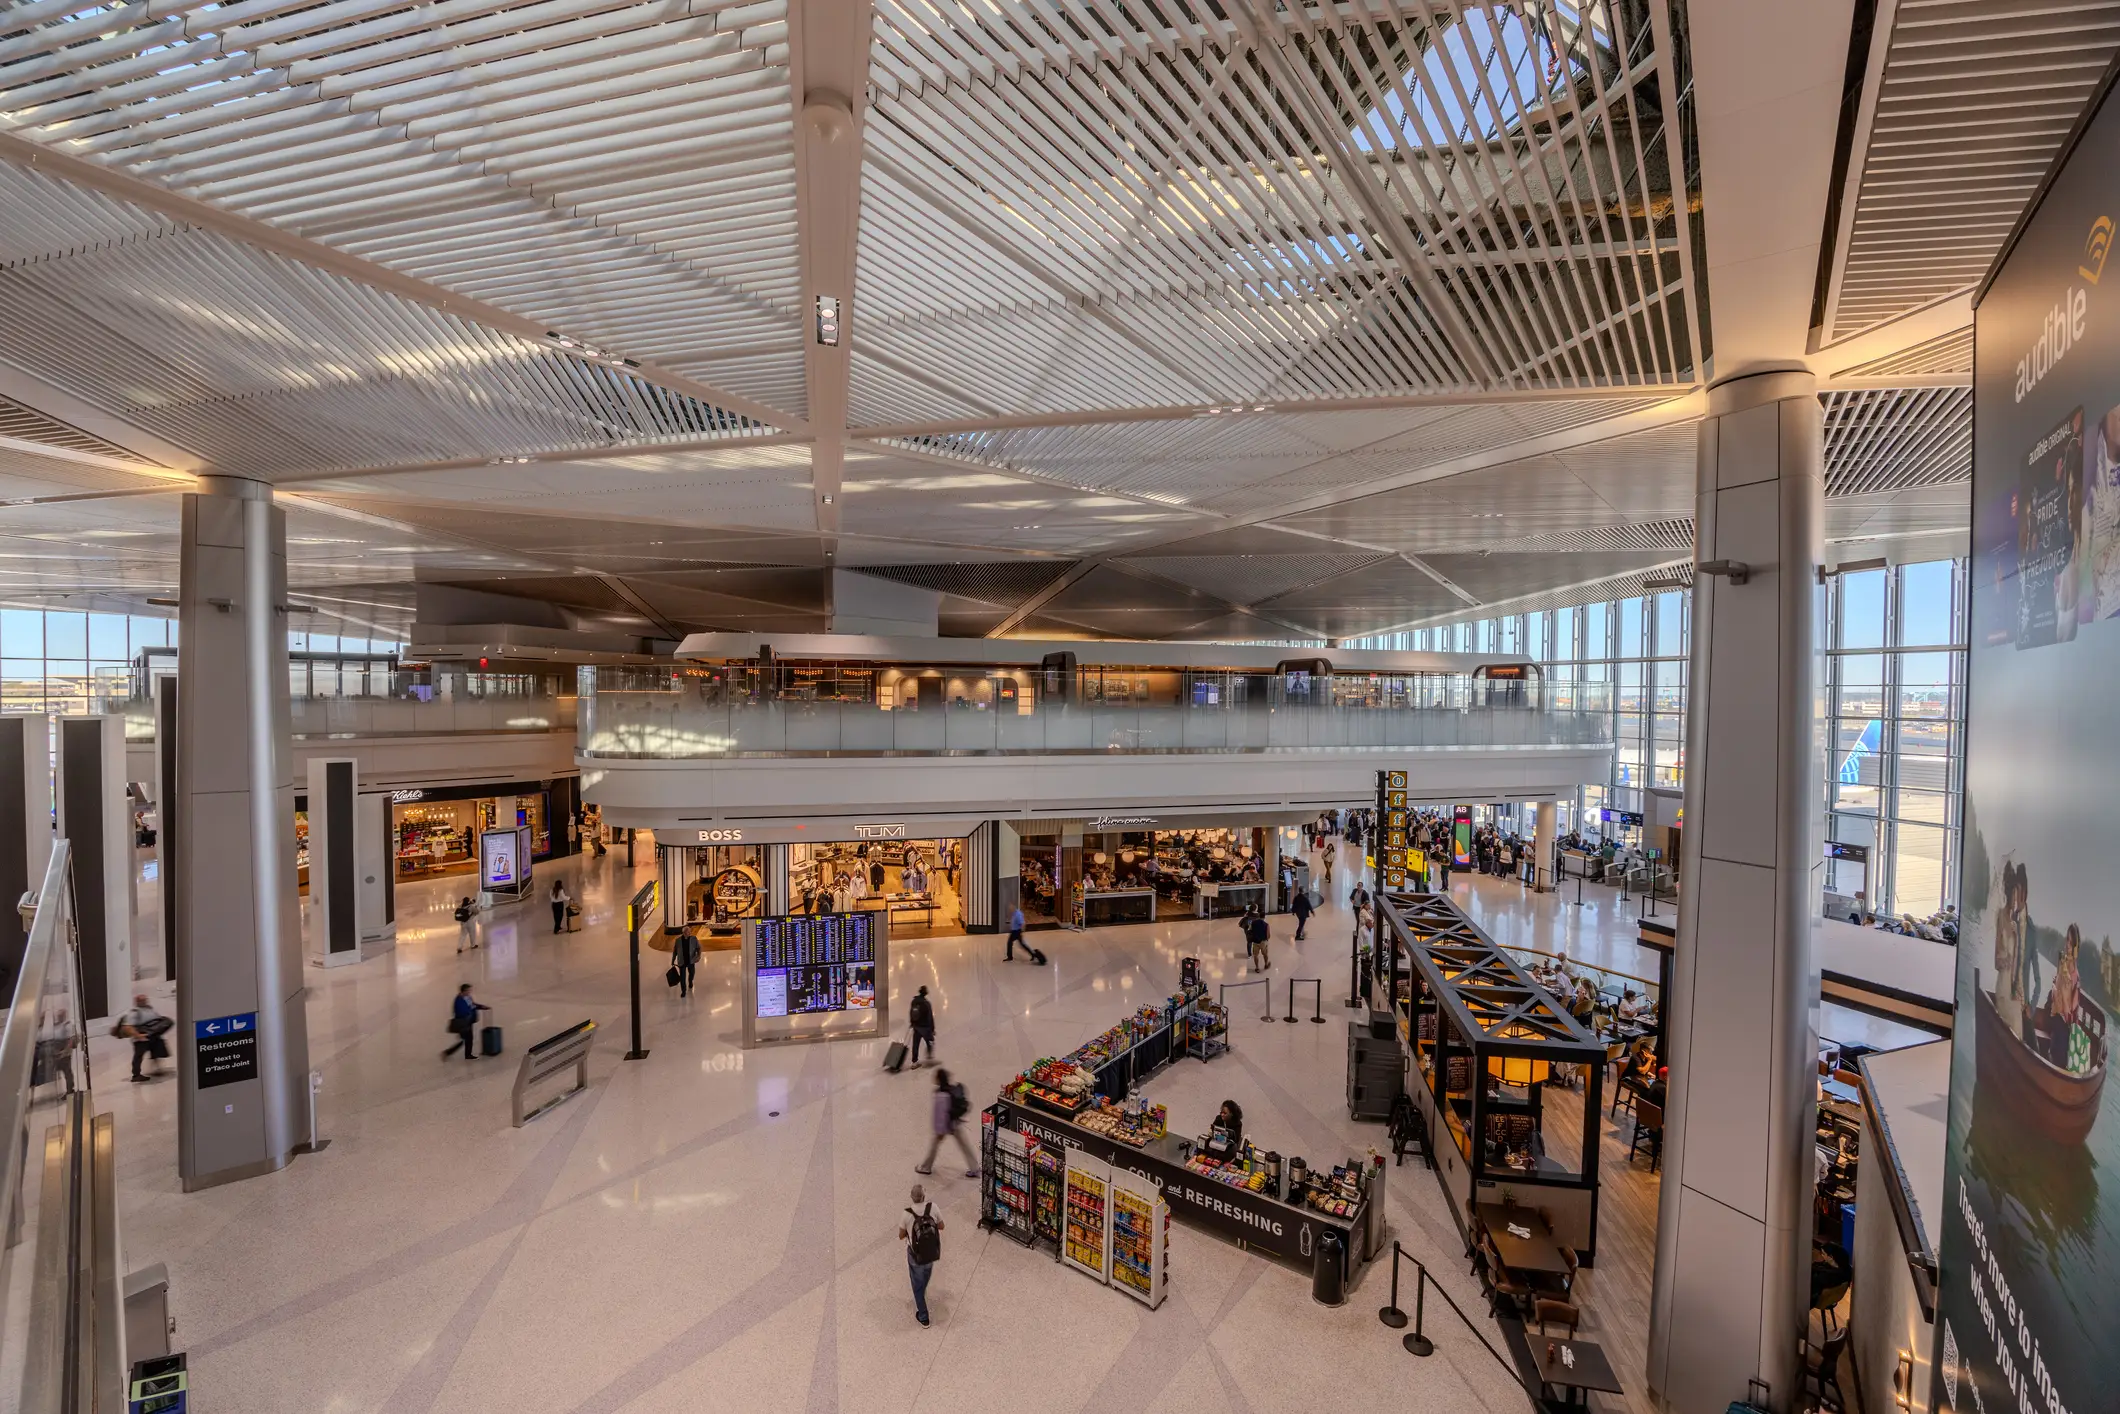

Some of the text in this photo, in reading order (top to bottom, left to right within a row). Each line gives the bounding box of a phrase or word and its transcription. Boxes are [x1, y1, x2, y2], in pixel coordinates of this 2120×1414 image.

[2015, 286, 2087, 404] audible
[2028, 420, 2071, 466] audible ORIGINAL
[2037, 499, 2059, 525] PRIDE
[2027, 546, 2067, 579] PREJUDICE
[392, 789, 423, 802] Kiehl's
[698, 829, 742, 841] BOSS
[854, 823, 905, 838] TUMI
[199, 1037, 254, 1053] Restrooms
[214, 1054, 231, 1063] Next
[205, 1060, 250, 1073] D'Taco Joint
[1022, 1121, 1080, 1150] MARKET
[1167, 1184, 1182, 1195] and
[1185, 1187, 1283, 1236] REFRESHING
[1959, 1174, 2074, 1414] There's more to ima
[1970, 1263, 1996, 1342] when
[1995, 1328, 2017, 1396] you
